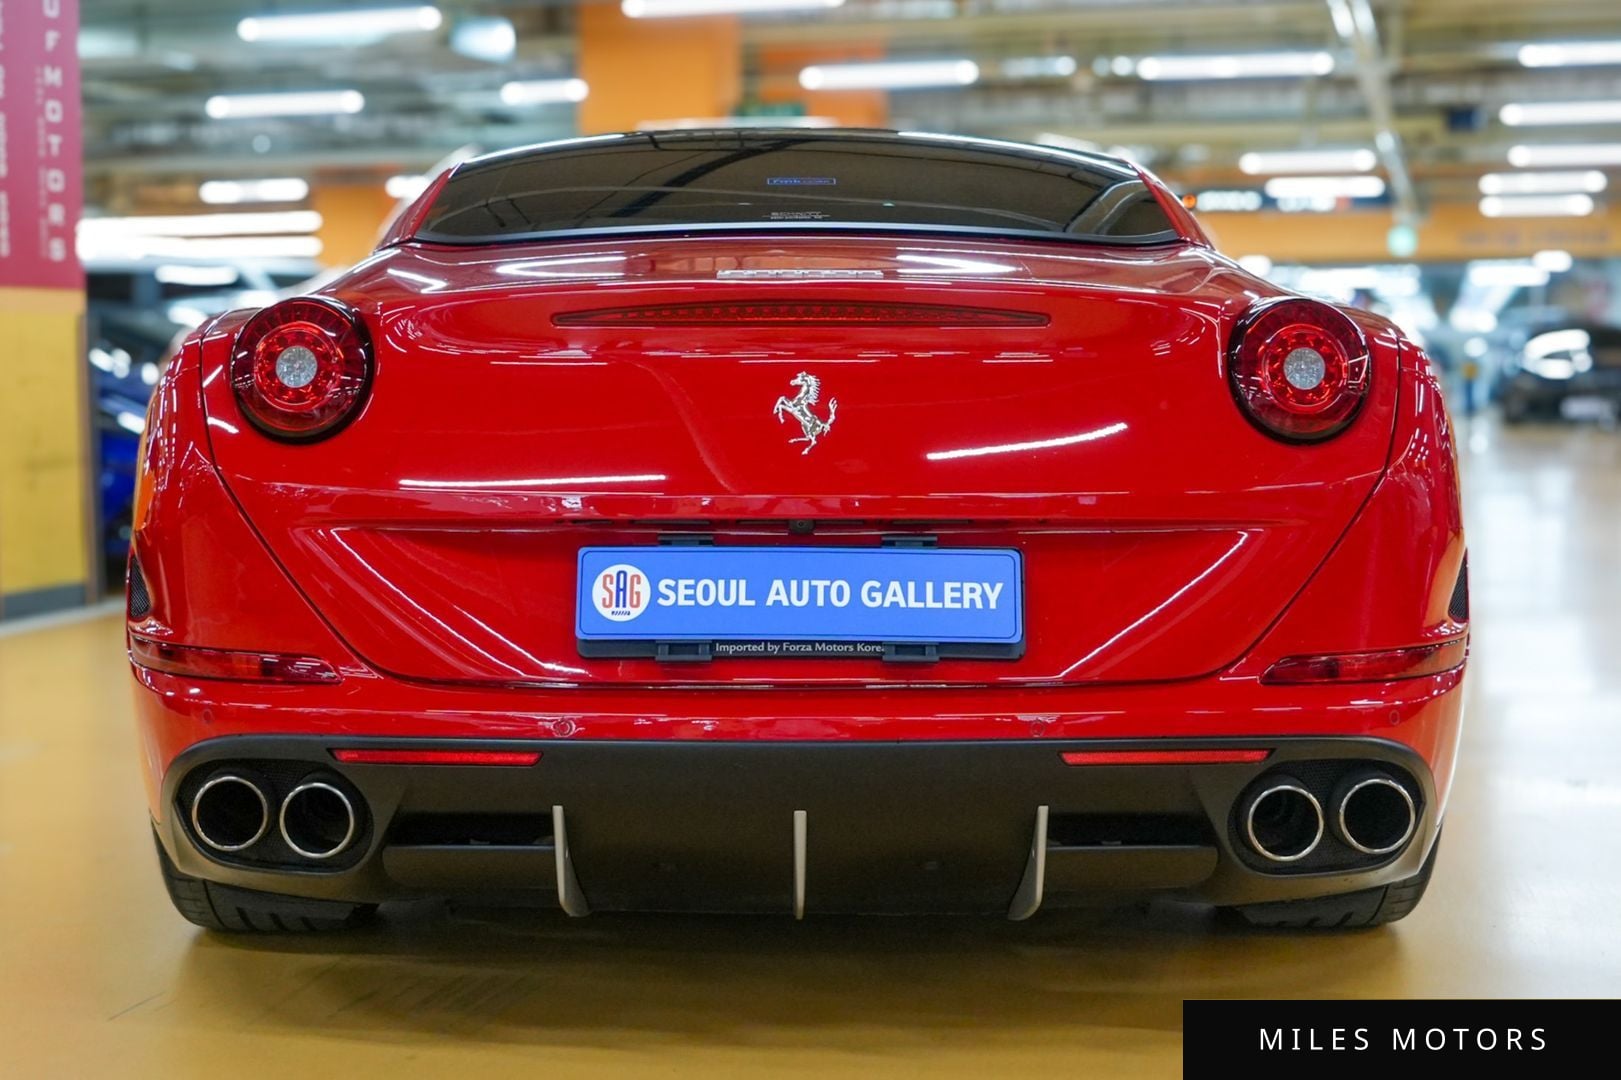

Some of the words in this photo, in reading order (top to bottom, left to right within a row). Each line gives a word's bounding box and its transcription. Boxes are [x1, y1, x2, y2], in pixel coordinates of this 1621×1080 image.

[602, 570, 641, 608] SAG
[657, 578, 755, 607] SEOUL
[765, 579, 850, 608] AUTO
[860, 580, 1003, 610] GALLERY
[715, 642, 765, 655] Imported
[767, 642, 780, 655] by
[782, 643, 812, 652] Forza
[815, 643, 854, 652] Motors
